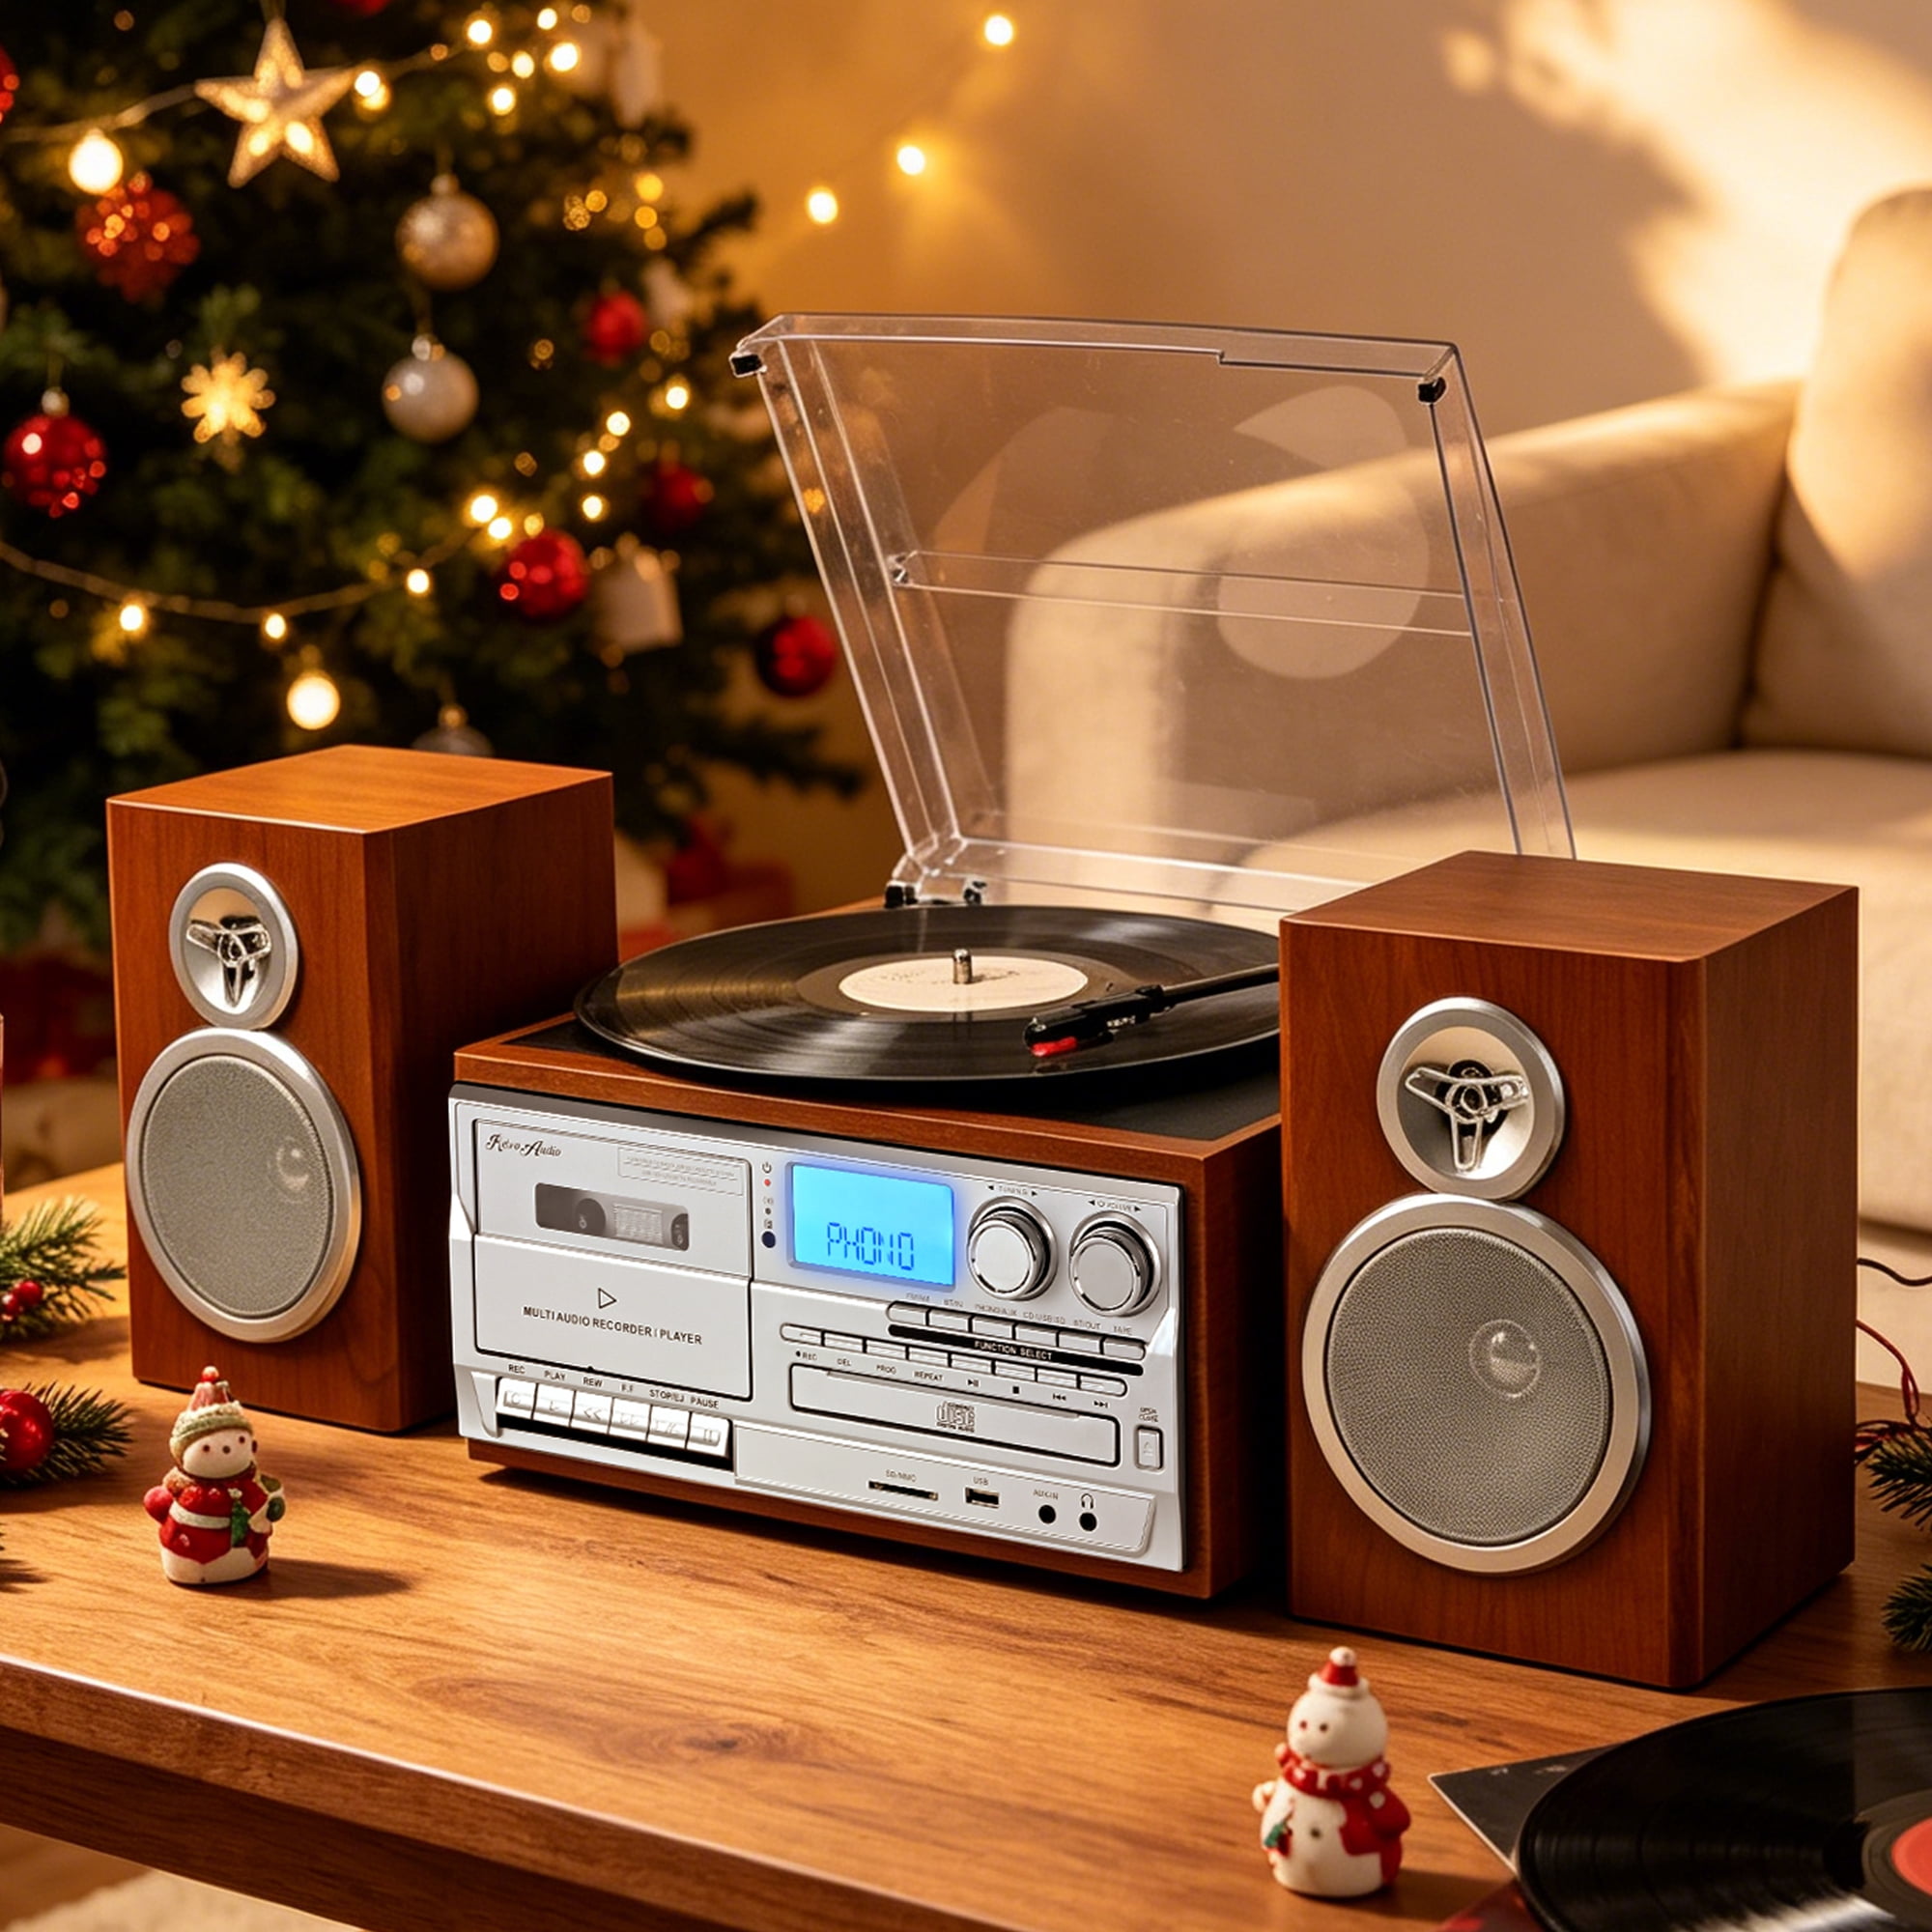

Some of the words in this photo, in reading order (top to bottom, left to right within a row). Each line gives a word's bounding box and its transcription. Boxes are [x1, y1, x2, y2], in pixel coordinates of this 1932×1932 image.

[522, 1140, 561, 1156] Audio
[827, 1222, 914, 1271] PHONO
[523, 1306, 555, 1321] MULTI
[555, 1312, 591, 1327] AUDIO
[592, 1318, 652, 1338] RECORDER
[659, 1328, 703, 1346] PLAYER
[802, 1351, 818, 1361] REC
[974, 1340, 1016, 1354] FUNCTION
[1020, 1347, 1053, 1361] SELECT
[837, 1357, 852, 1367] DEL
[508, 1363, 526, 1375] REC
[876, 1364, 897, 1376] PROG
[544, 1370, 566, 1381] PLAY
[914, 1370, 943, 1381] REPEAT
[582, 1376, 603, 1388] REW
[690, 1396, 720, 1409] PAUSE
[973, 1476, 989, 1486] USB
